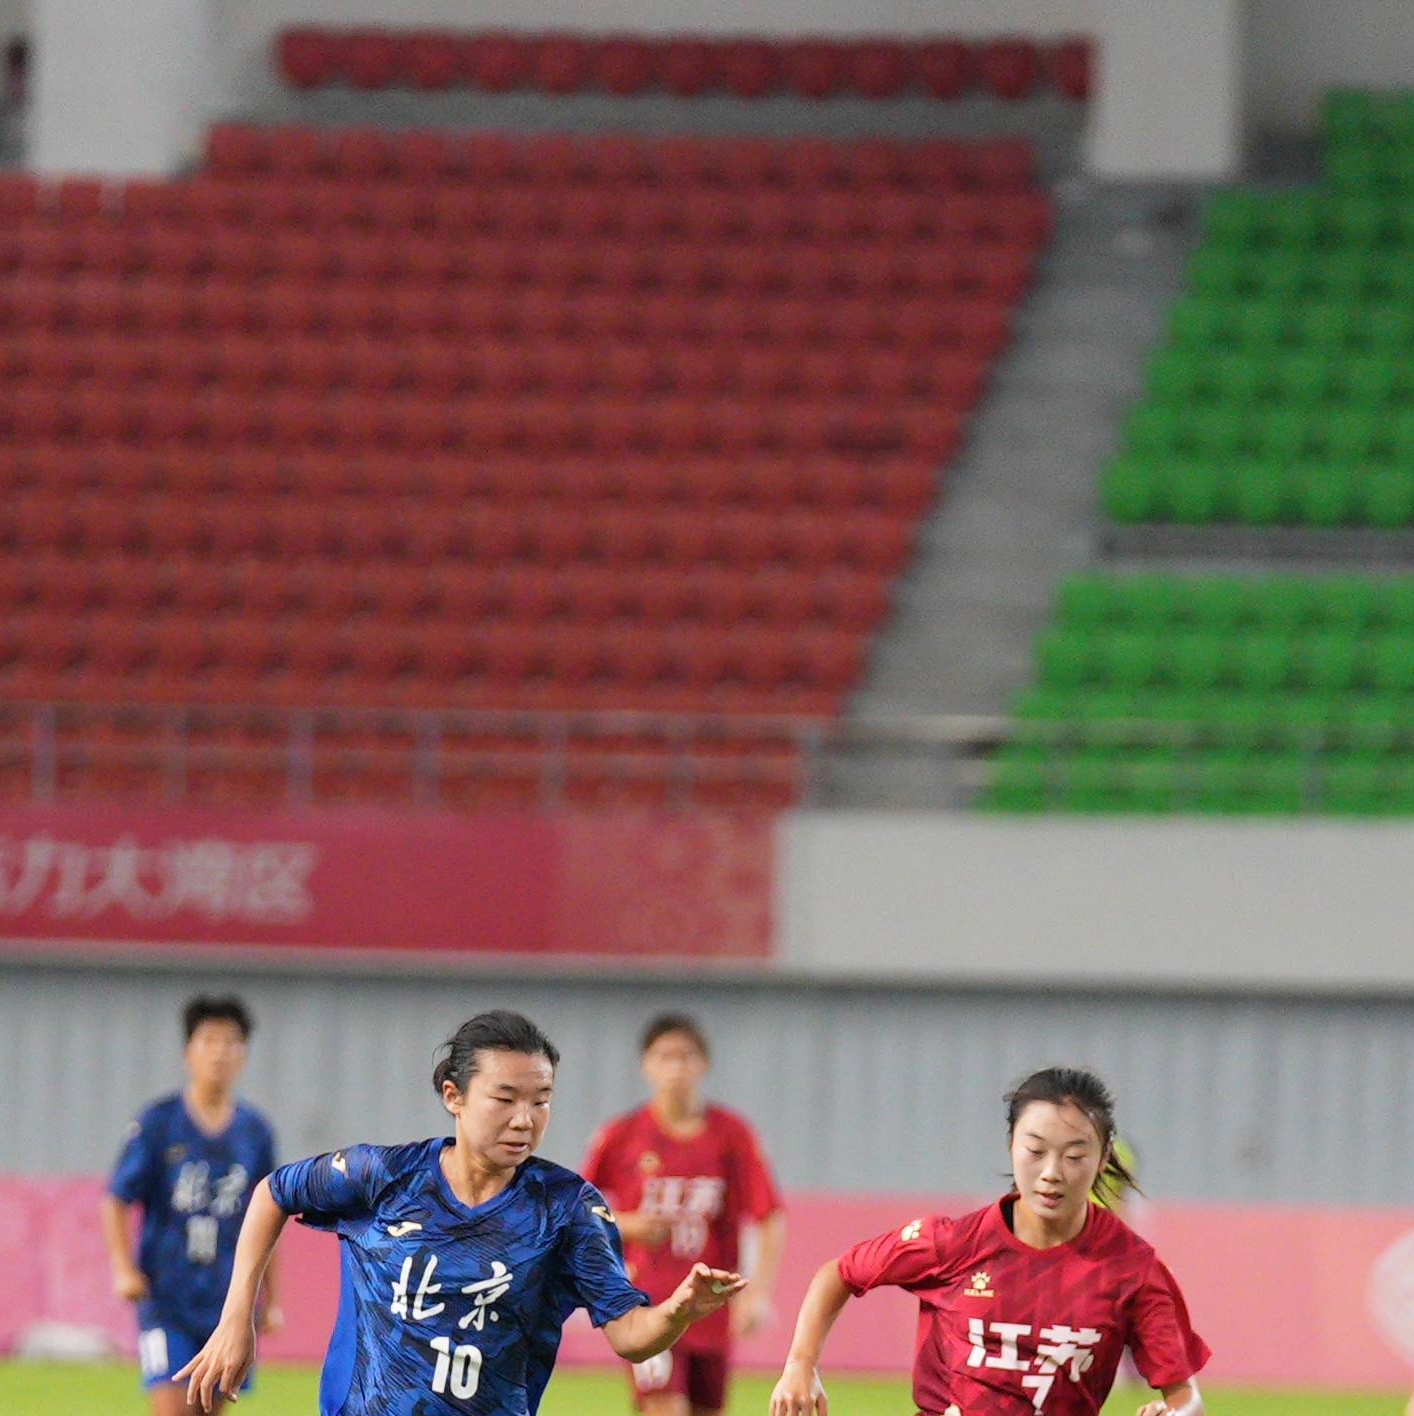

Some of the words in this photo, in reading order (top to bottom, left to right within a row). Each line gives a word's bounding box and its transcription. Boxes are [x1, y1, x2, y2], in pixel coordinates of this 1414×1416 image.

[390, 1254, 514, 1331] 北京
[430, 1336, 482, 1400] 10
[966, 1317, 1103, 1382] 江苏
[1021, 1375, 1055, 1416] 7
